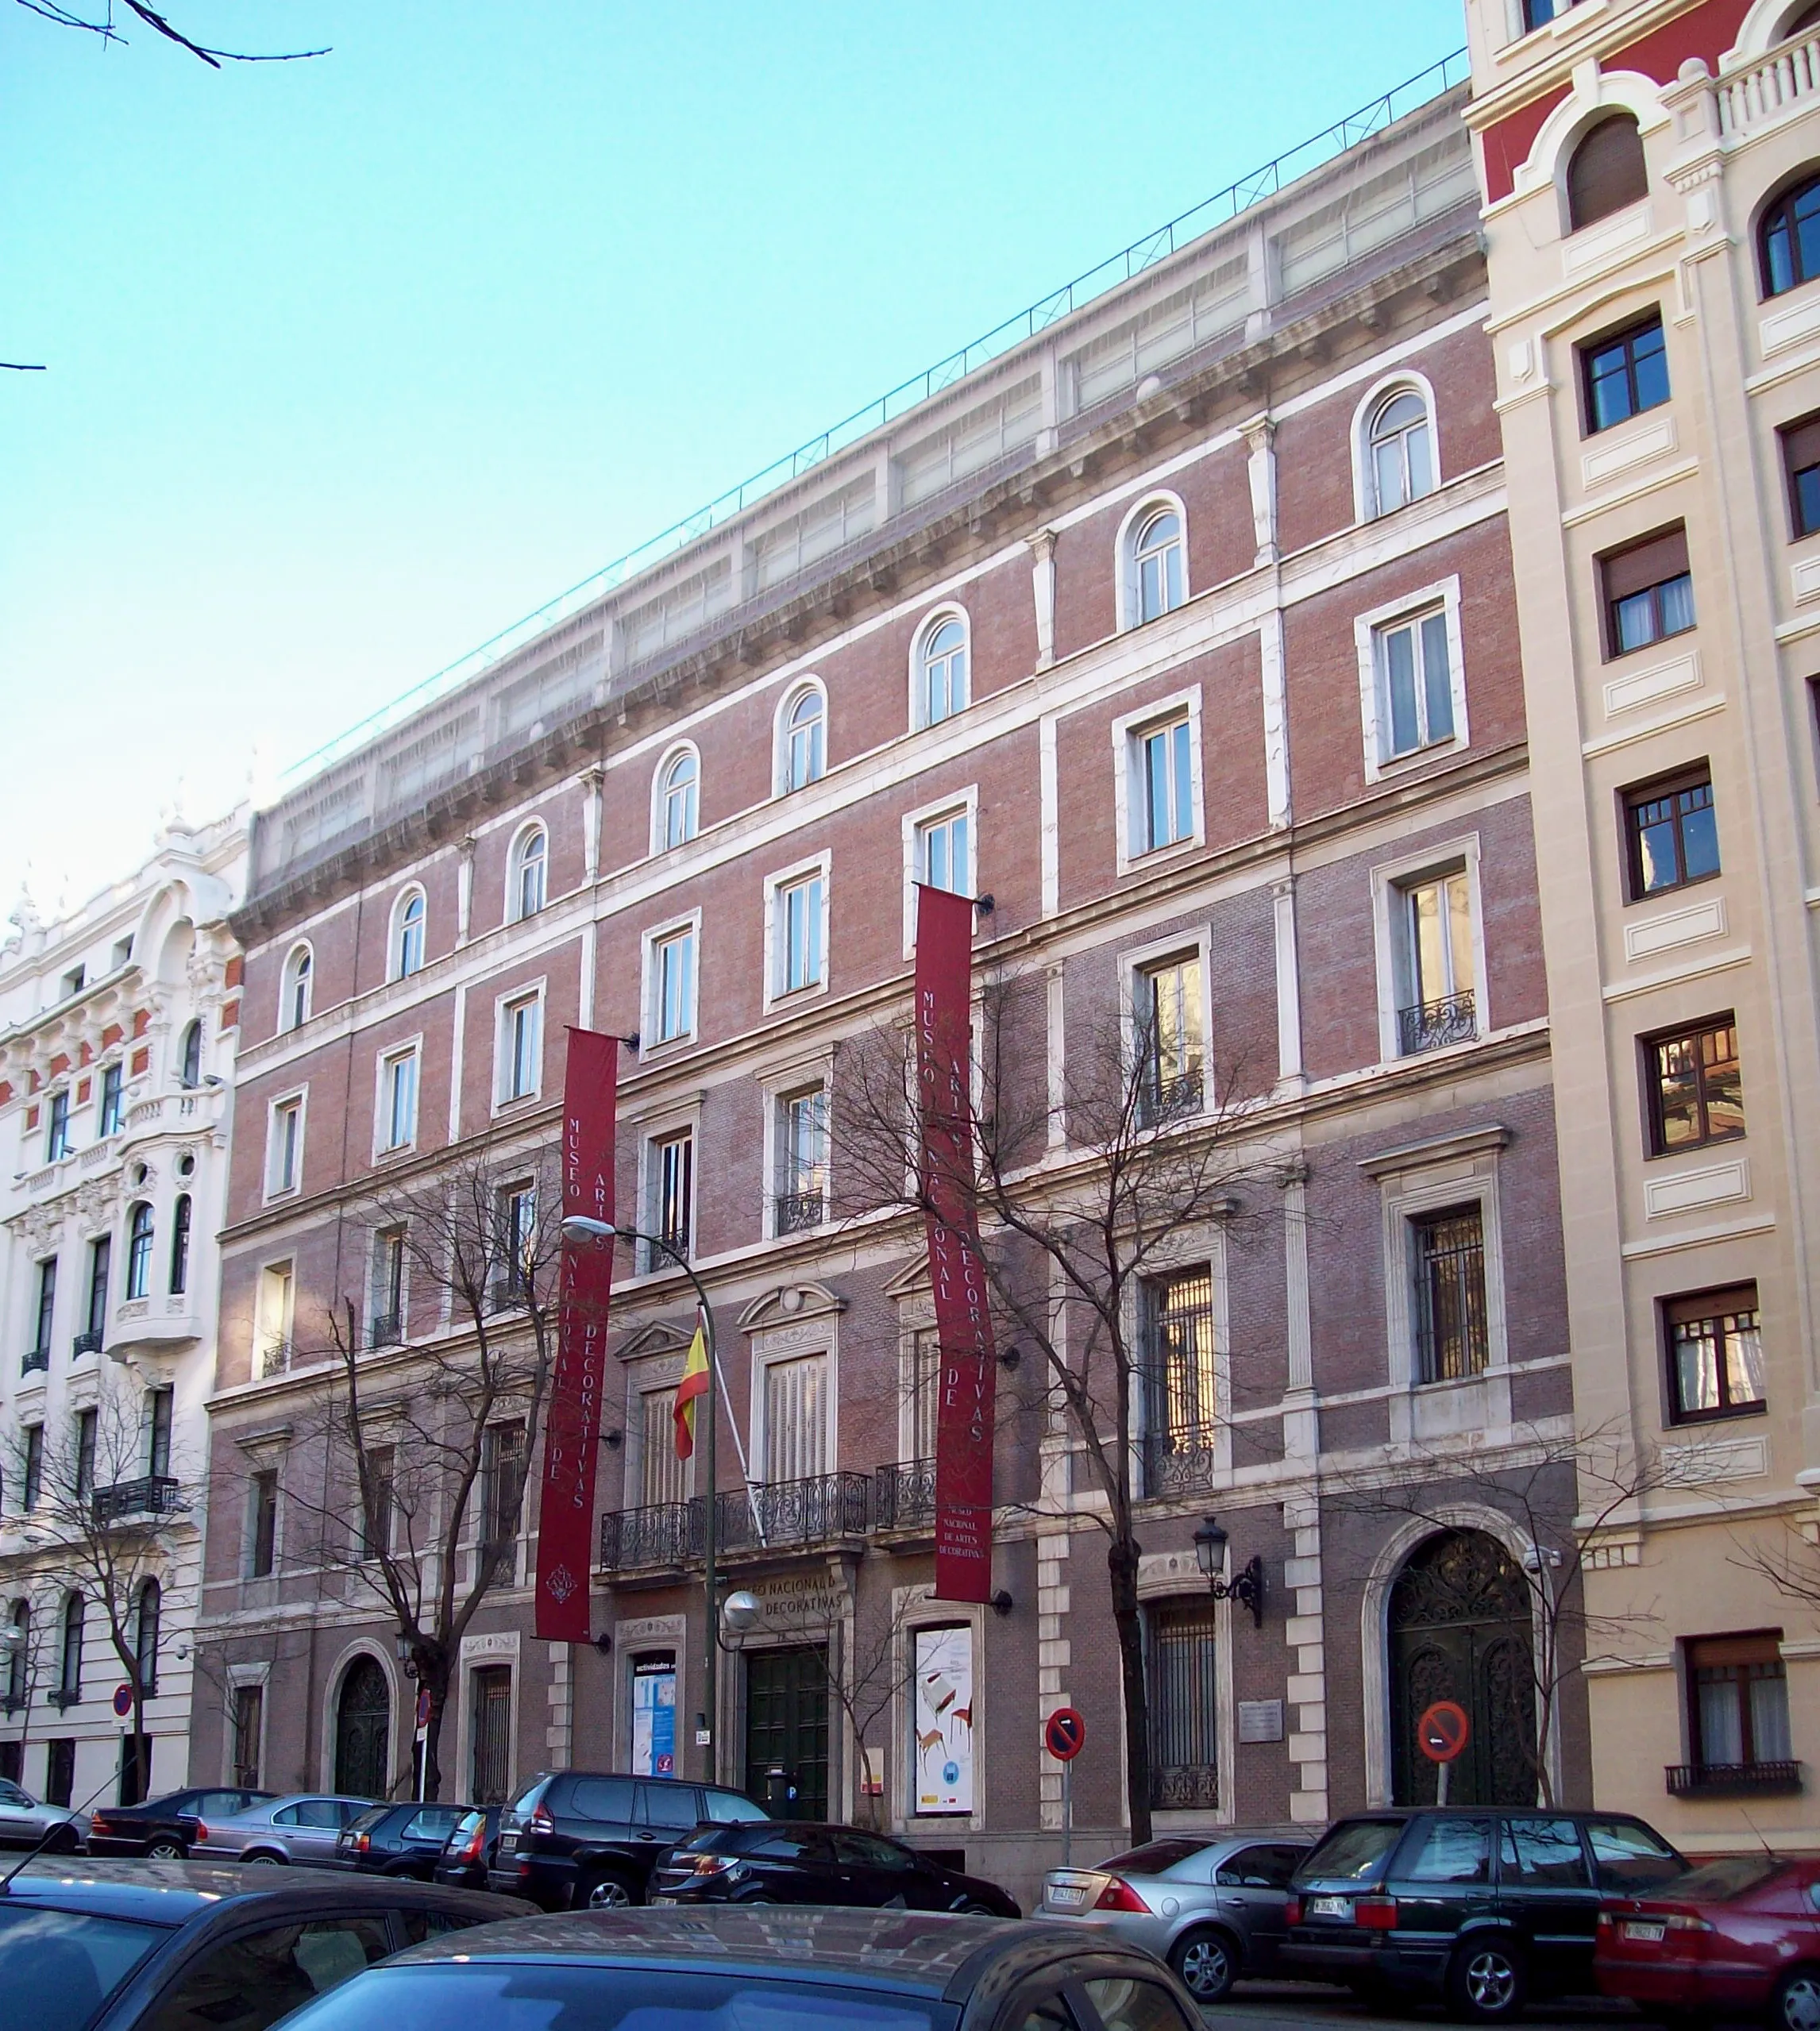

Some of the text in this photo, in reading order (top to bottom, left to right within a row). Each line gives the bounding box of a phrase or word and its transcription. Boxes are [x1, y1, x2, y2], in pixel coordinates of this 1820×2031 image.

[550, 1118, 580, 1479] MUSEO NACIONAL DE
[573, 1173, 606, 1509] ARTS DECORATIVAS
[947, 1368, 958, 1406] DE
[943, 1517, 977, 1532] NACIONAL
[944, 1532, 977, 1544] DE ARTES
[769, 1577, 826, 1595] NACIONAL
[766, 1594, 842, 1616] DECORATIVAS
